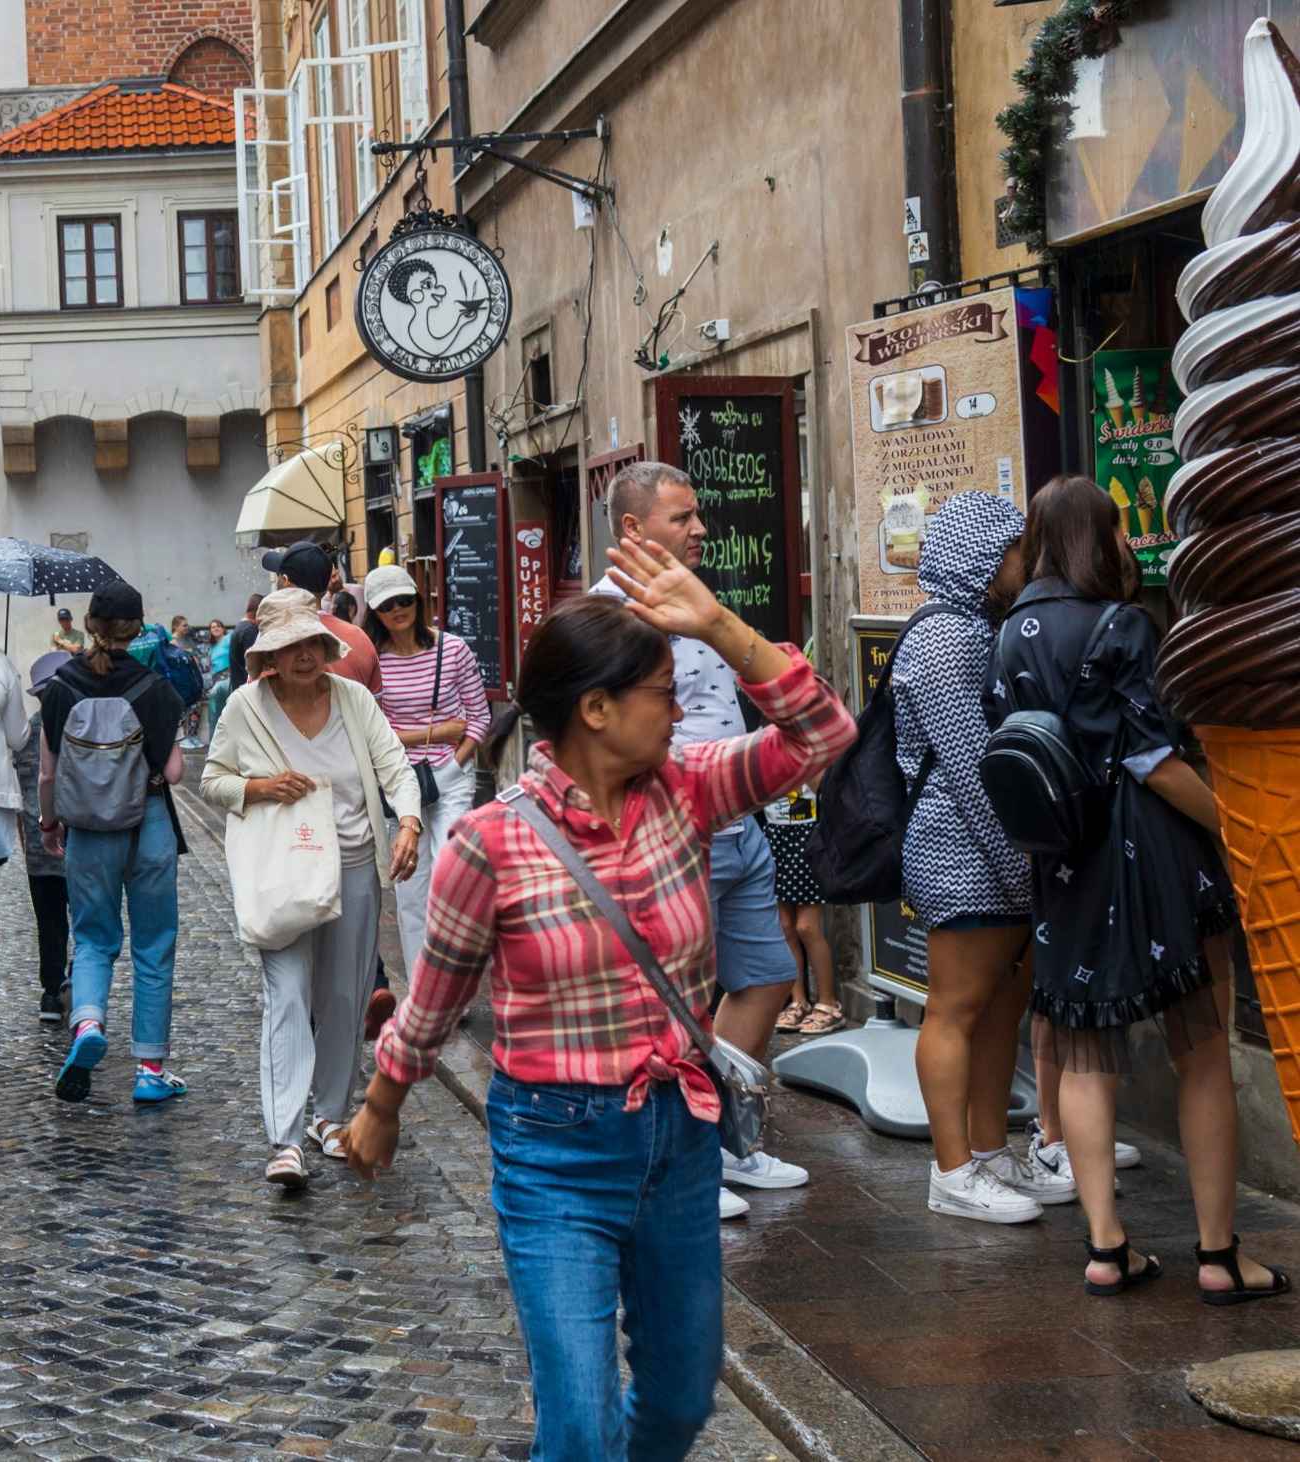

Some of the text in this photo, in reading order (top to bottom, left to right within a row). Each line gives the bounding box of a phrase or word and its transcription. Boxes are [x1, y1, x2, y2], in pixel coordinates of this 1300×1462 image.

[880, 428, 957, 448] WANILIOWY
[1098, 413, 1175, 444] Świderki
[890, 440, 967, 459] ORZECHAMI
[891, 453, 966, 473] MIGDAŁAMI
[892, 465, 975, 485] CYNAMONEM
[520, 556, 532, 623] BUŁKA
[532, 561, 543, 625] PIECZ
